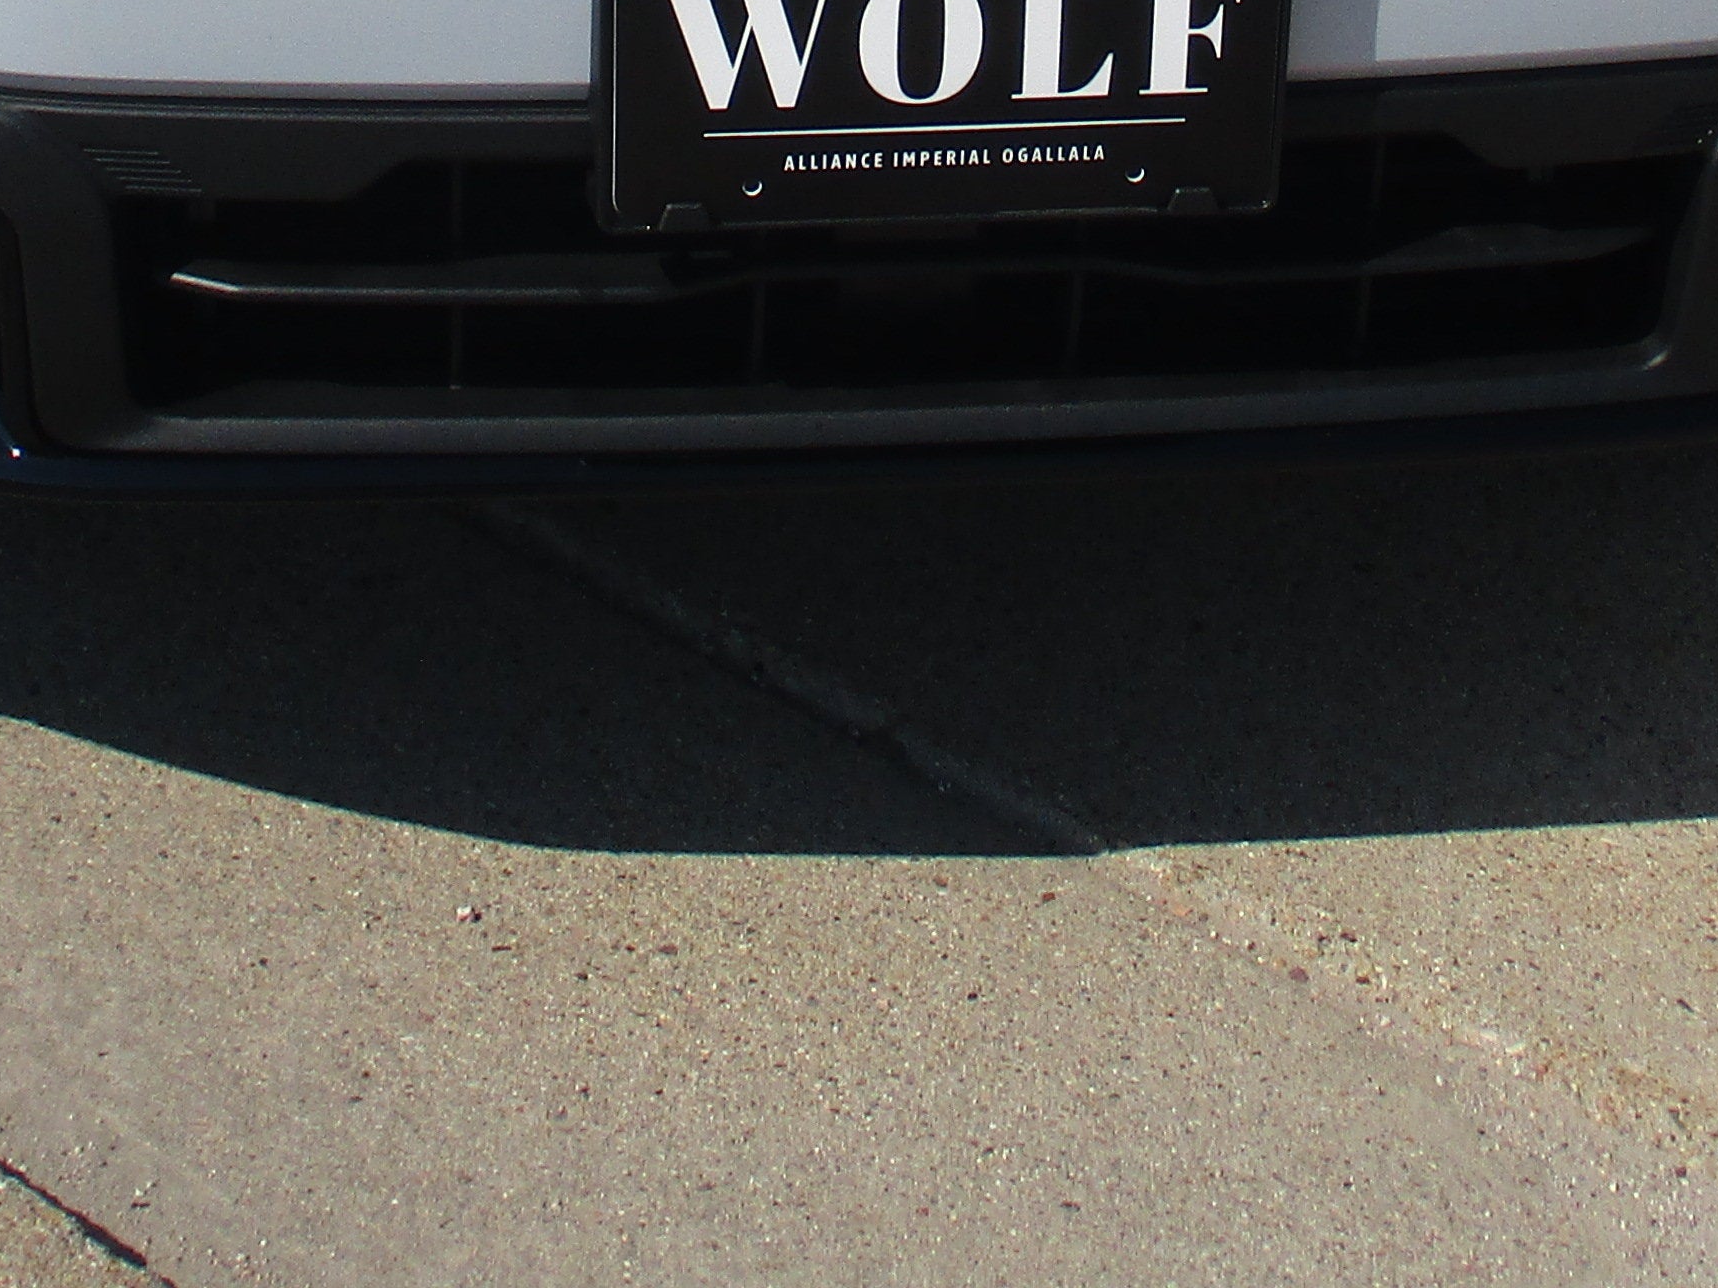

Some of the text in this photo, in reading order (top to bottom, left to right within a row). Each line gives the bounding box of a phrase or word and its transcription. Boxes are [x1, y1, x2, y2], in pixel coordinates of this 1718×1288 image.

[783, 144, 1105, 171] ALLIANCE IMPERIAL OGALLALA
